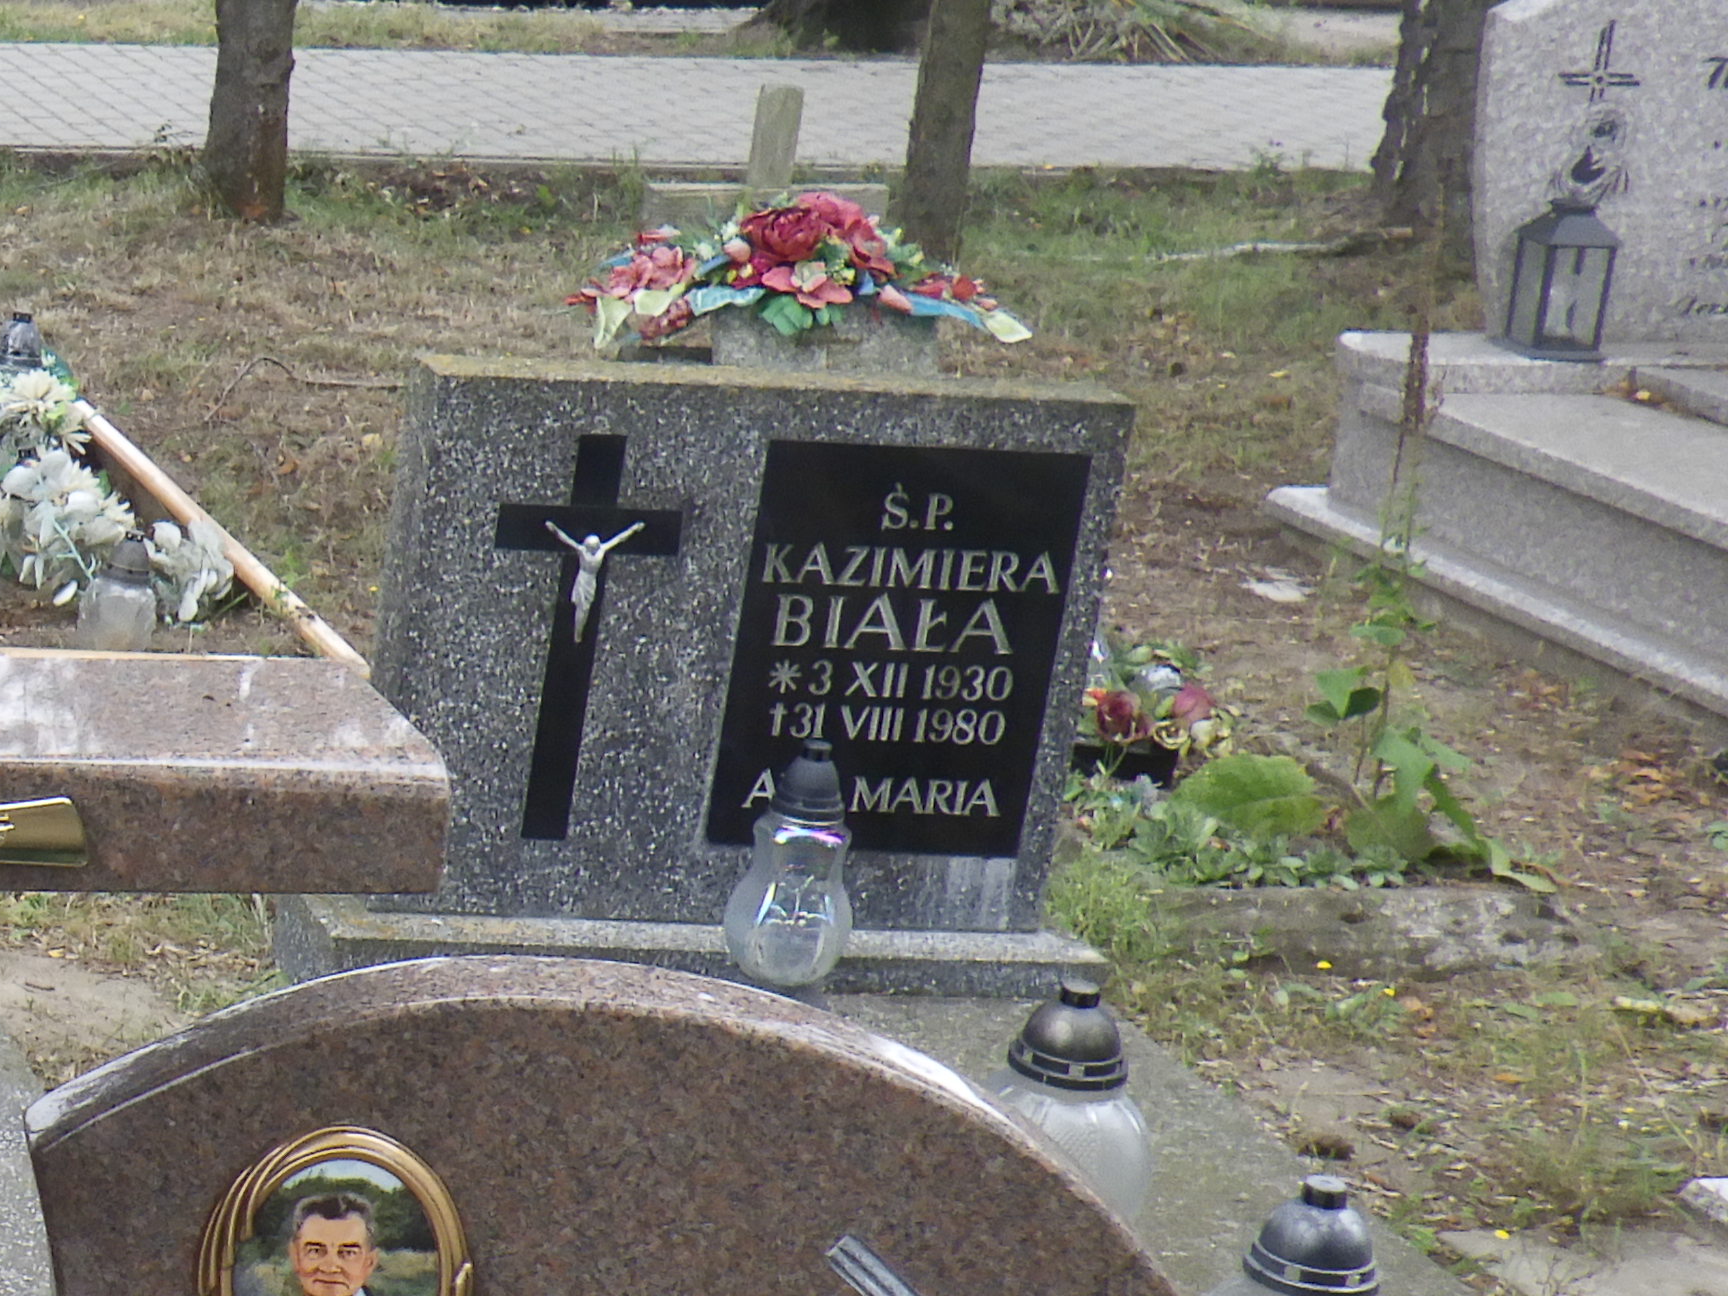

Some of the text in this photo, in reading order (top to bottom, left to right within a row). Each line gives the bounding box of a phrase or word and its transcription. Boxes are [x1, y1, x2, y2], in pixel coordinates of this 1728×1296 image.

[760, 541, 1061, 594] KAZIMIERA
[770, 592, 1015, 656] BIAŁA
[844, 661, 910, 699] XII
[921, 664, 1015, 702] 1930
[841, 705, 905, 742] VIII
[913, 708, 1006, 746] 1980
[847, 775, 1001, 818] MARIA
